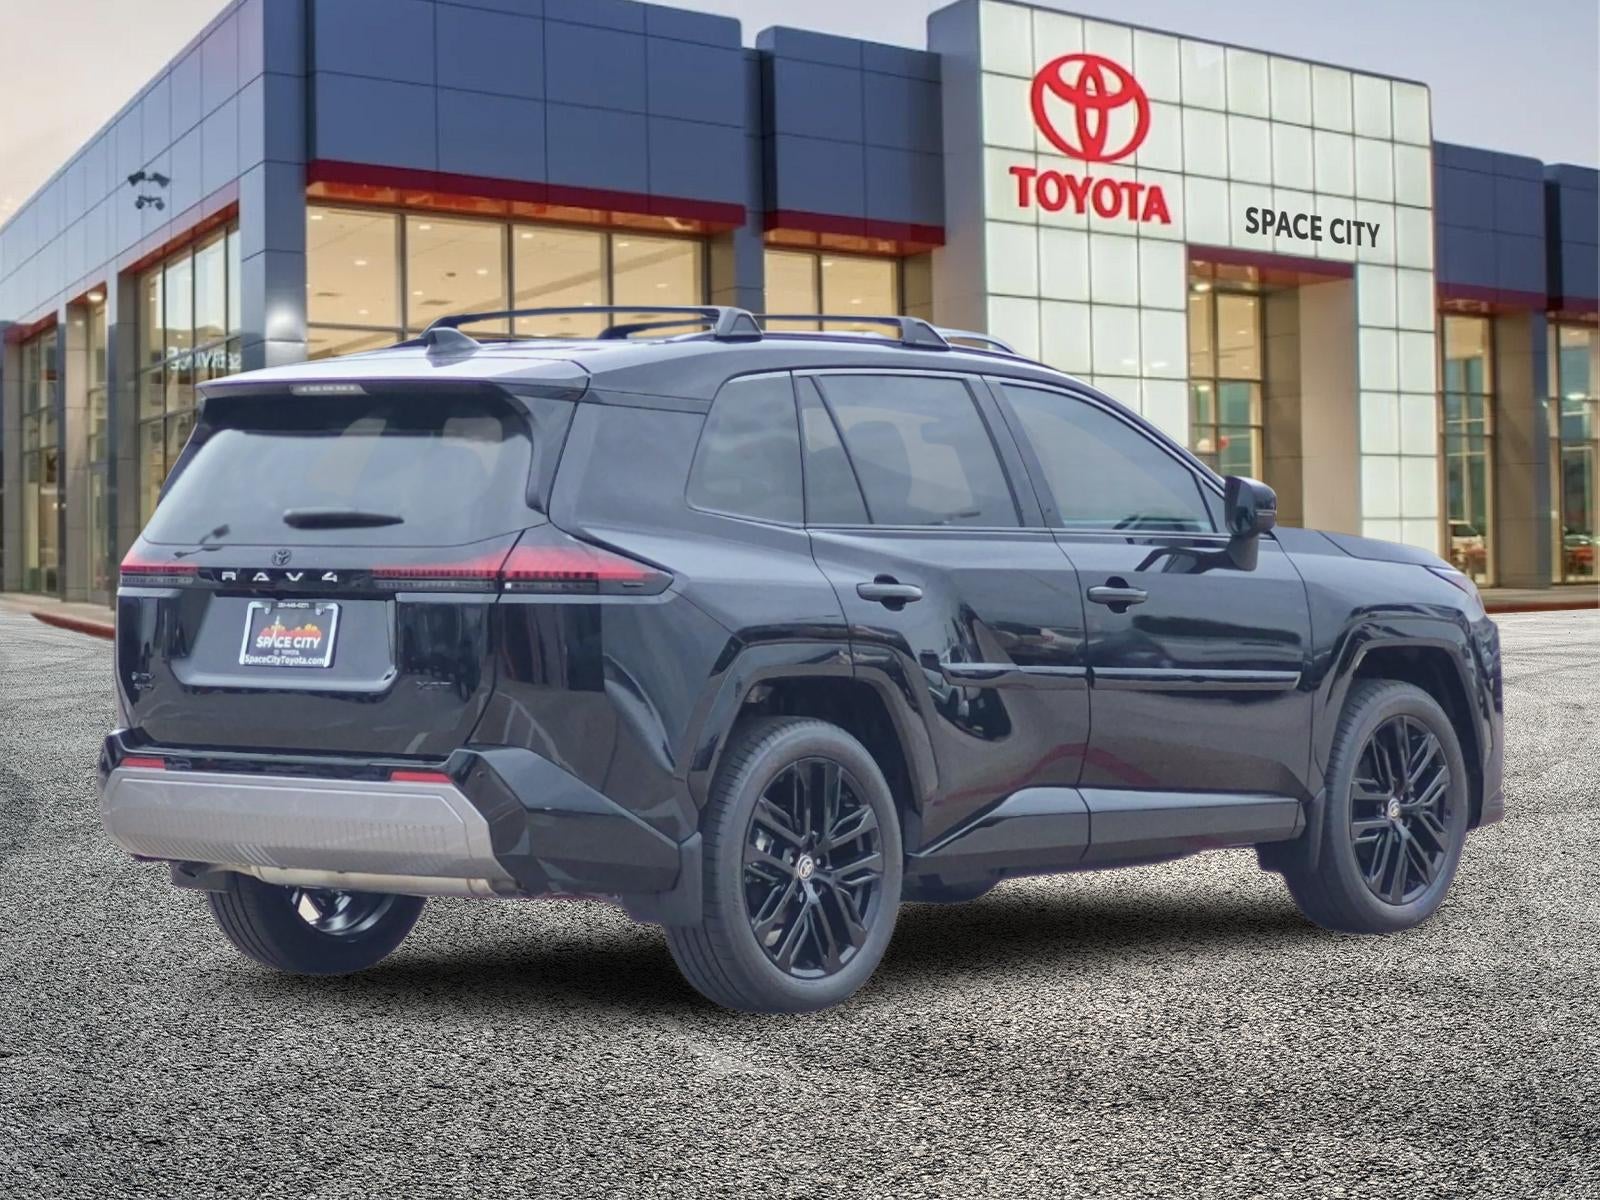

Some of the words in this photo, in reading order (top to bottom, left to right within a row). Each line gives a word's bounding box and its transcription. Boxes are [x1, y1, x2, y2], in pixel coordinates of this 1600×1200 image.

[1009, 166, 1172, 225] TOYOTA
[1245, 206, 1323, 242] SPACE
[1329, 218, 1381, 248] CITY
[255, 635, 291, 648] SPACE
[292, 636, 322, 649] CITY
[245, 654, 326, 666] SpaceCityToyota.com
